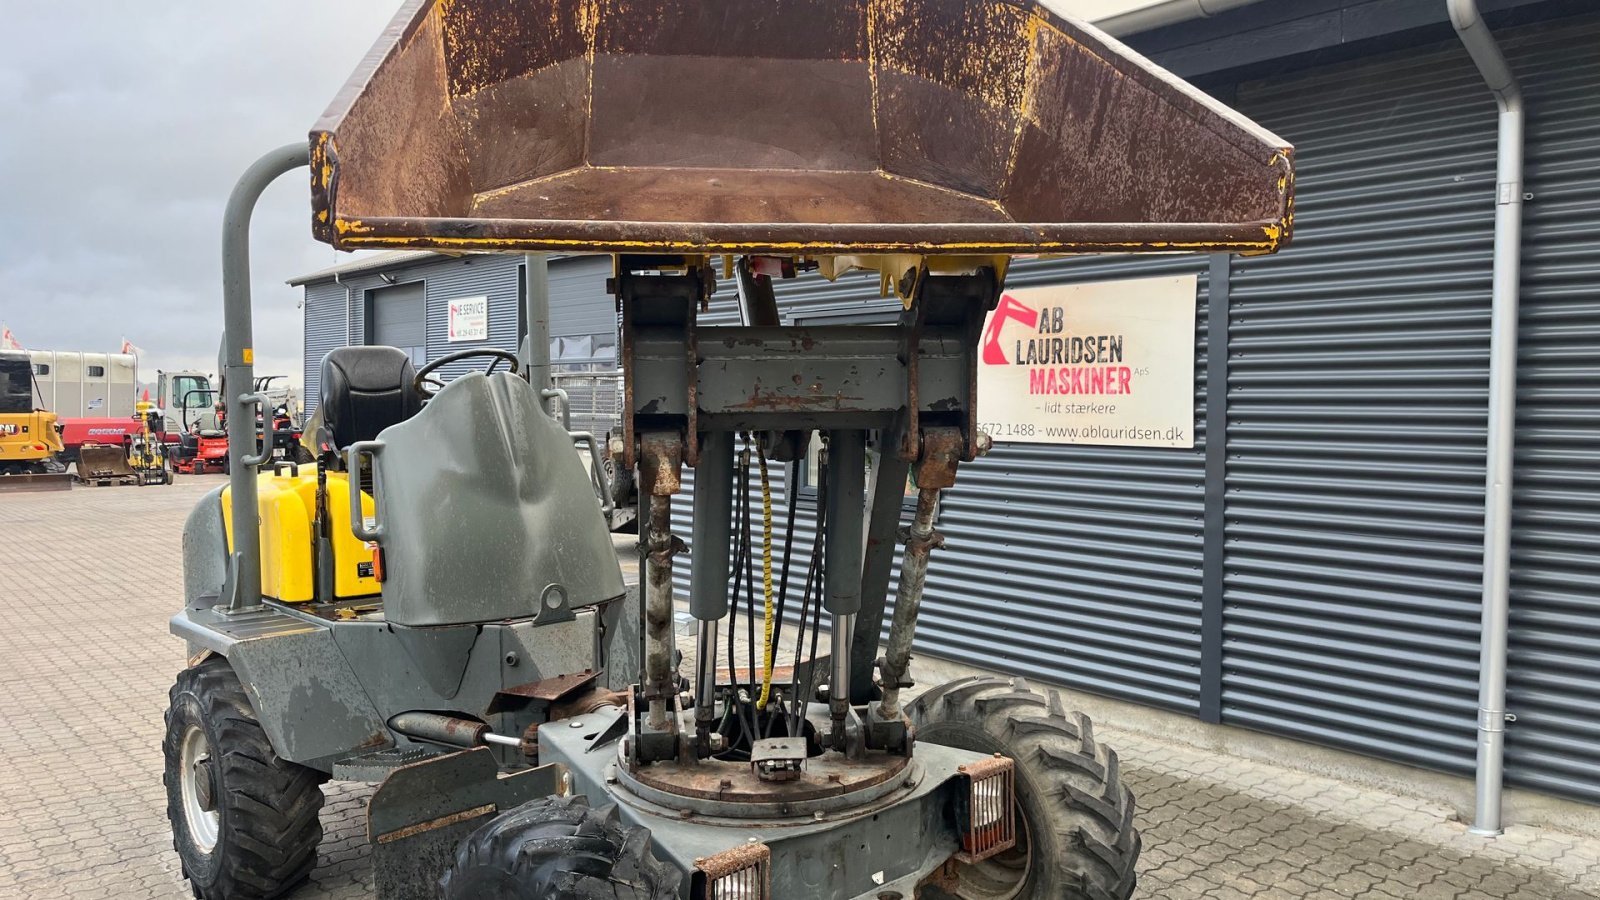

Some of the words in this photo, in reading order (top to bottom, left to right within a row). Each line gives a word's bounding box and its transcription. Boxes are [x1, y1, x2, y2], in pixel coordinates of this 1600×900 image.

[463, 302, 484, 316] SERVICE
[1039, 307, 1064, 334] AB
[1016, 335, 1123, 365] LAURIDSEN
[1030, 367, 1131, 395] MASKINER
[1134, 367, 1150, 376] ApS
[1044, 402, 1061, 413] lidt
[1065, 402, 1116, 414] stærkere
[1006, 423, 1035, 437] 1488
[1046, 425, 1184, 440] www.ablauridsen.dk
